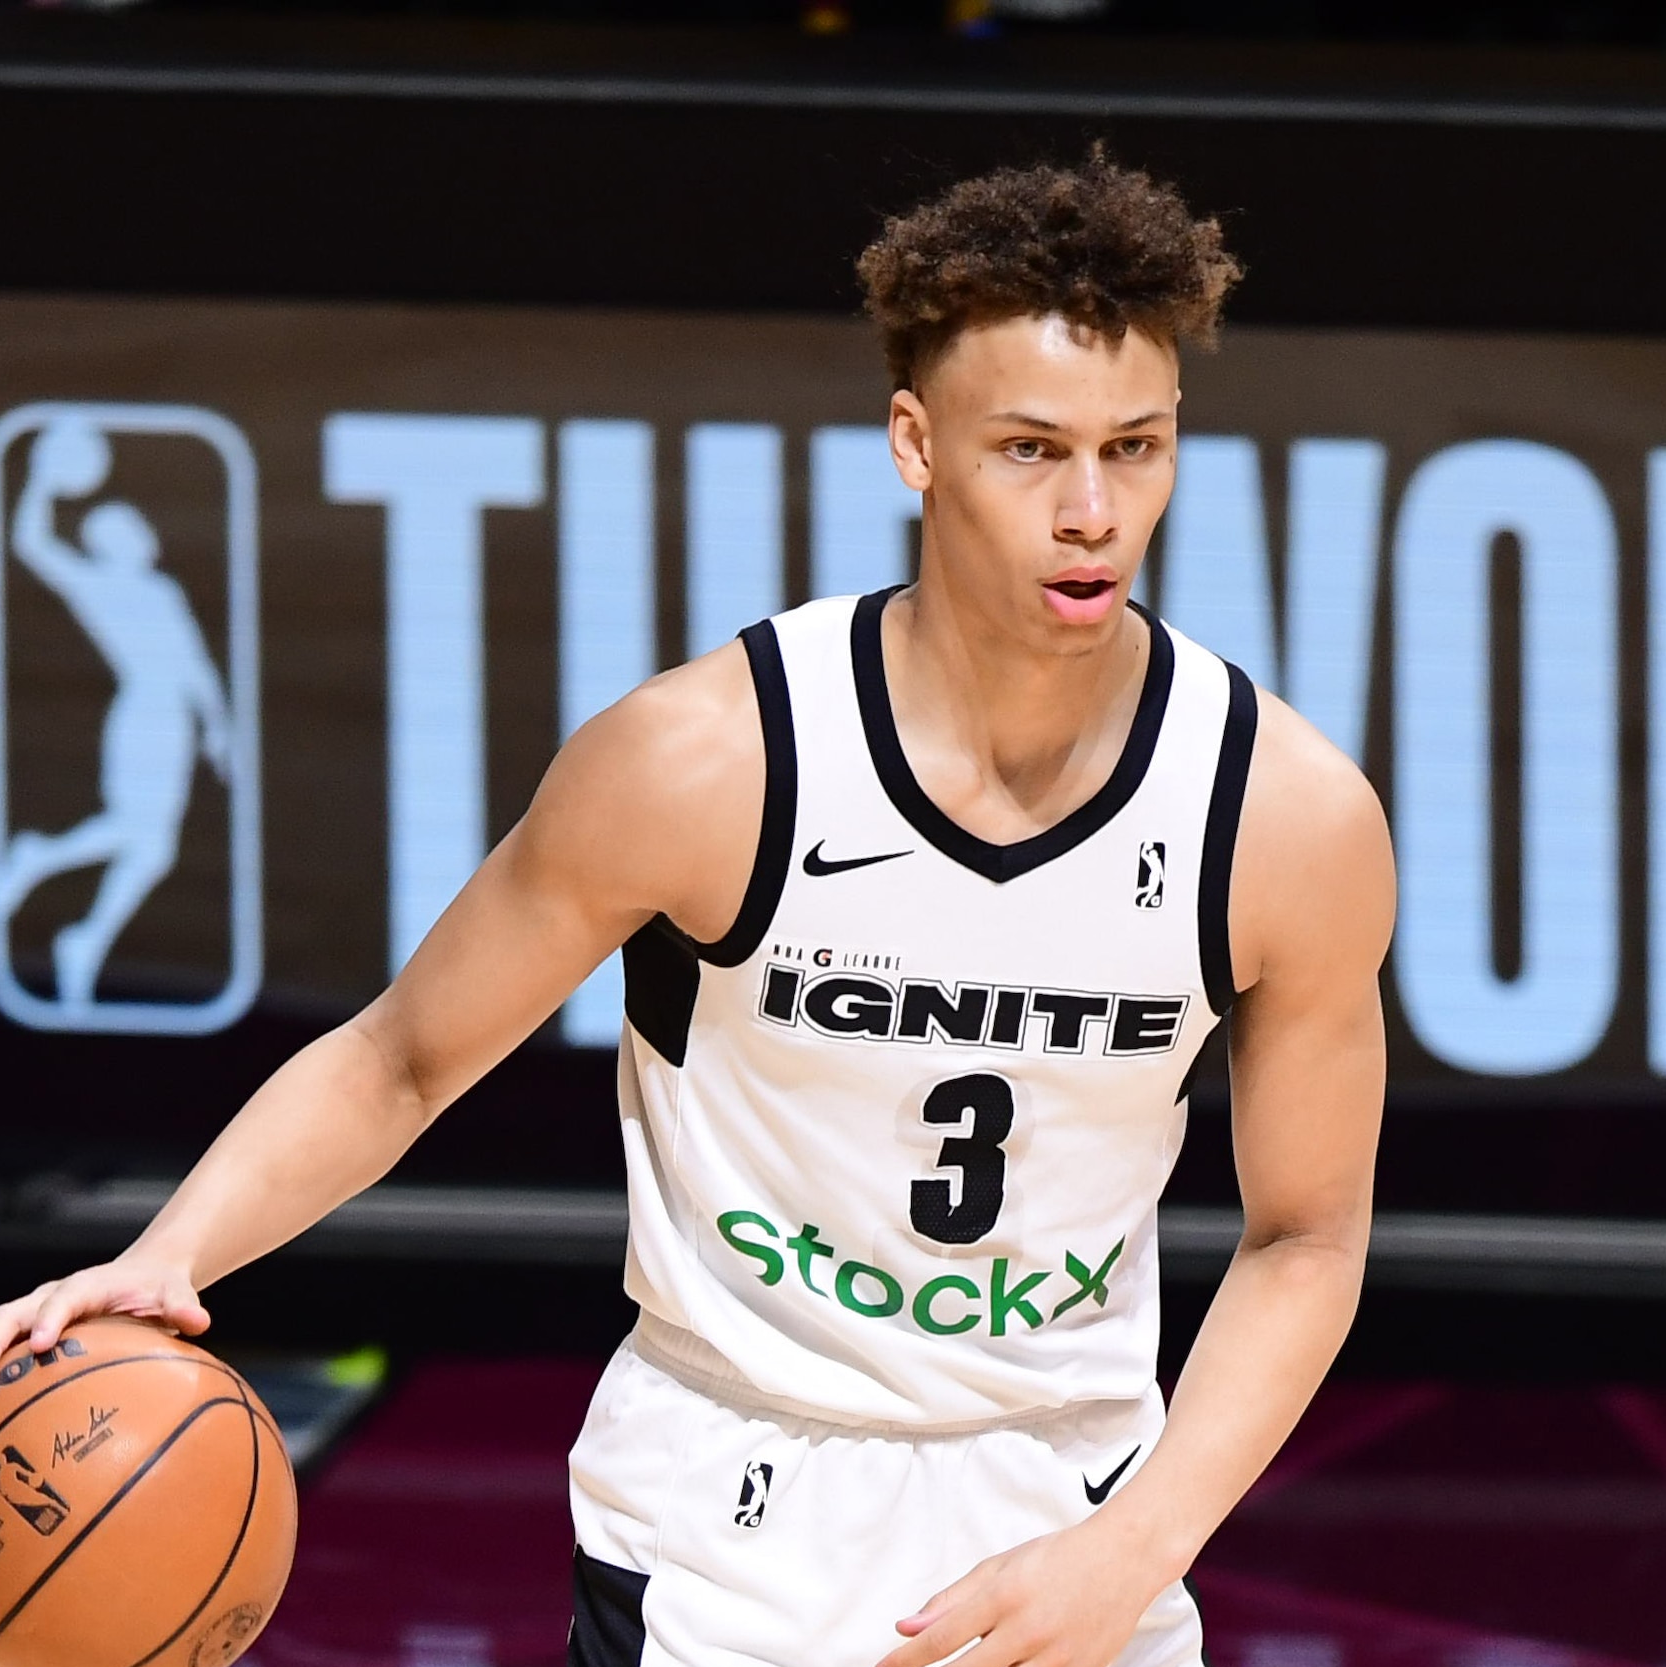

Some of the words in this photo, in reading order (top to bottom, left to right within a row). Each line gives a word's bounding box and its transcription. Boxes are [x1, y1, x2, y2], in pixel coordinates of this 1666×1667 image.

[773, 943, 803, 961] NBA
[843, 953, 901, 971] LEAGUE
[759, 962, 1190, 1057] IGNITE
[910, 1073, 1015, 1245] 3
